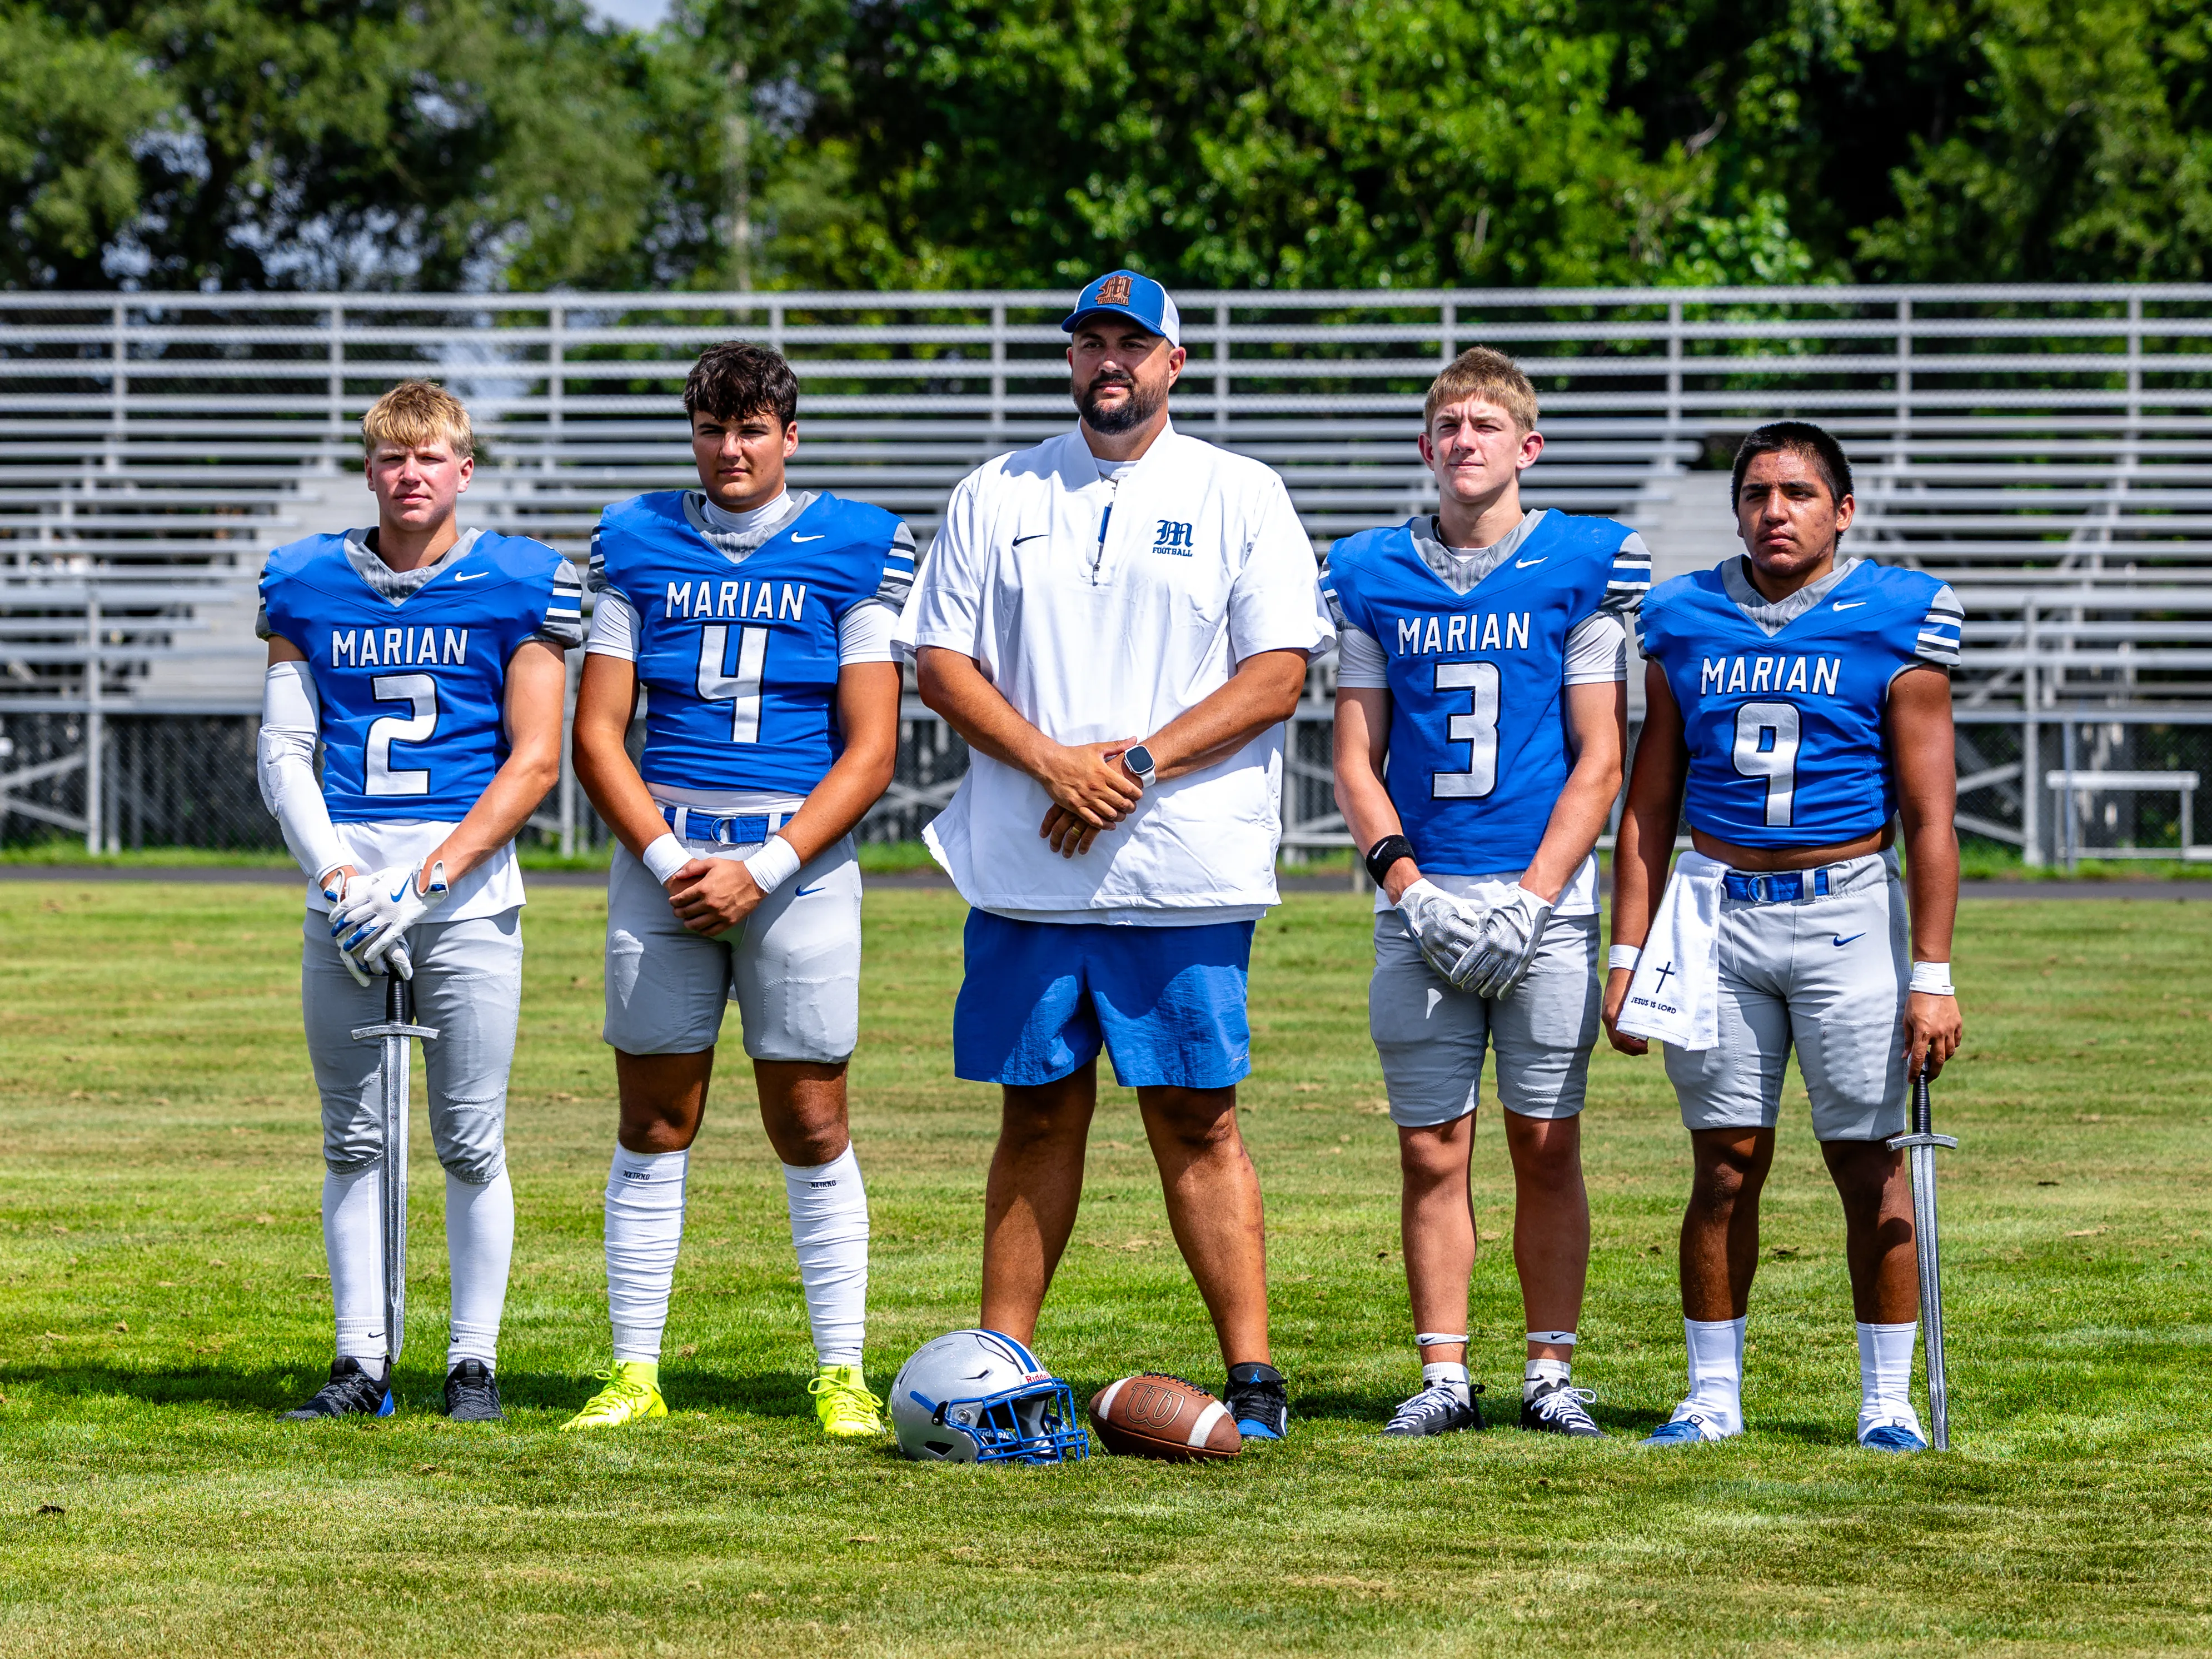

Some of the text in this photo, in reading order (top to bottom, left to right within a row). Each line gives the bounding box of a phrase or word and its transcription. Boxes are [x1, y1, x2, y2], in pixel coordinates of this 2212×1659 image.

[1098, 297, 1128, 305] FOOTBALL
[1152, 547, 1193, 557] FOOTBALL
[1153, 520, 1194, 547] M
[665, 580, 807, 621] MARIAN
[332, 626, 469, 667] MARIAN
[1397, 611, 1531, 655] MARIAN
[696, 625, 769, 744] 4
[1701, 656, 1841, 696] MARIAN
[364, 672, 438, 796] 2
[1432, 661, 1501, 799] 3
[1731, 701, 1801, 827] 9
[1631, 997, 1648, 1006] JESUS
[1657, 1003, 1676, 1014] LORD
[1125, 1382, 1185, 1429] W
